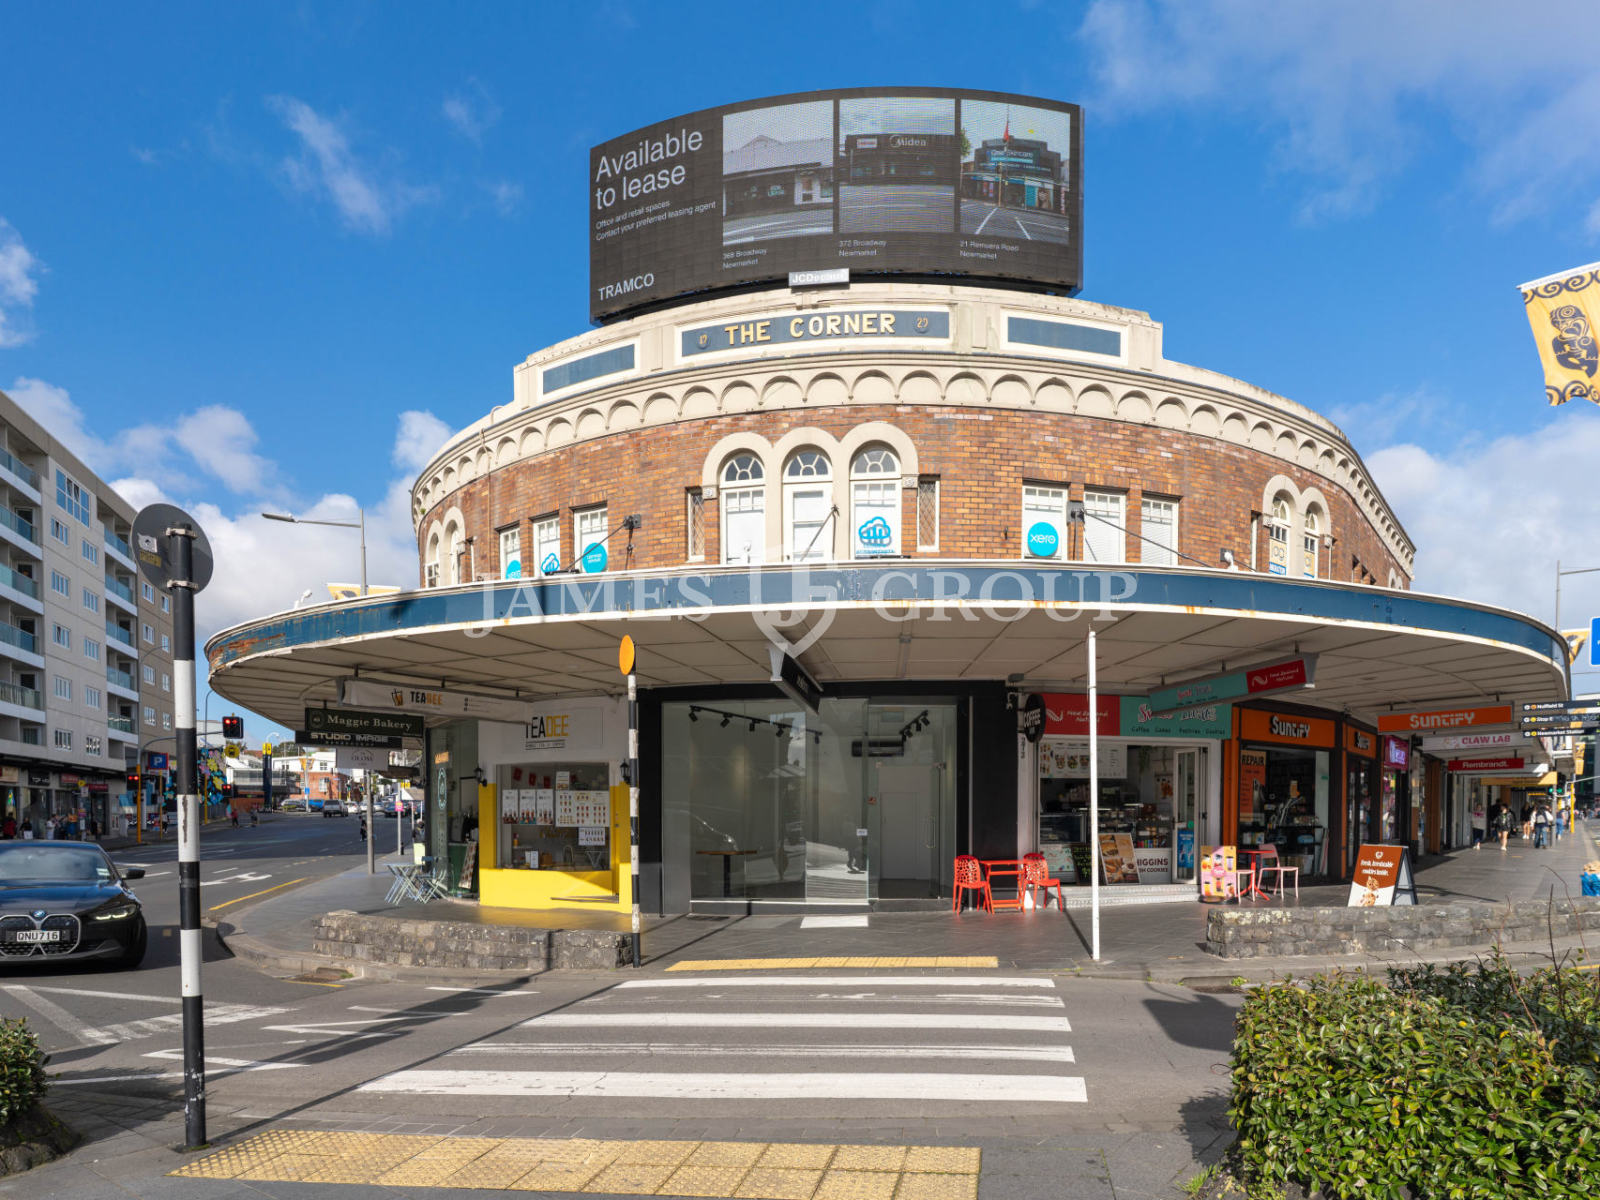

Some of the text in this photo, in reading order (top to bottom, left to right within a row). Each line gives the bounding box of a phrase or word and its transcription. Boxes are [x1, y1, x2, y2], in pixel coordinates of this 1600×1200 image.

[596, 128, 703, 182] Available
[596, 165, 686, 210] to lease
[595, 219, 613, 230] Office
[615, 212, 627, 222] and
[628, 206, 644, 217] retail
[595, 201, 716, 241] Contact your preferred leasing agent
[735, 248, 767, 258] Broadway
[838, 249, 877, 257] Newmarket
[960, 250, 997, 259] Newmarket
[722, 258, 758, 269] Newmarket
[598, 273, 654, 300] TRAMCO
[724, 320, 771, 345] THE
[789, 312, 896, 339] CORNER
[1030, 534, 1056, 544] xero
[327, 714, 412, 730] Maggie Bakery
[310, 732, 389, 743] STUDIO IMAGE
[1462, 734, 1511, 745] CLAW LAB
[154, 757, 163, 766] P
[1241, 755, 1265, 765] REPAIR
